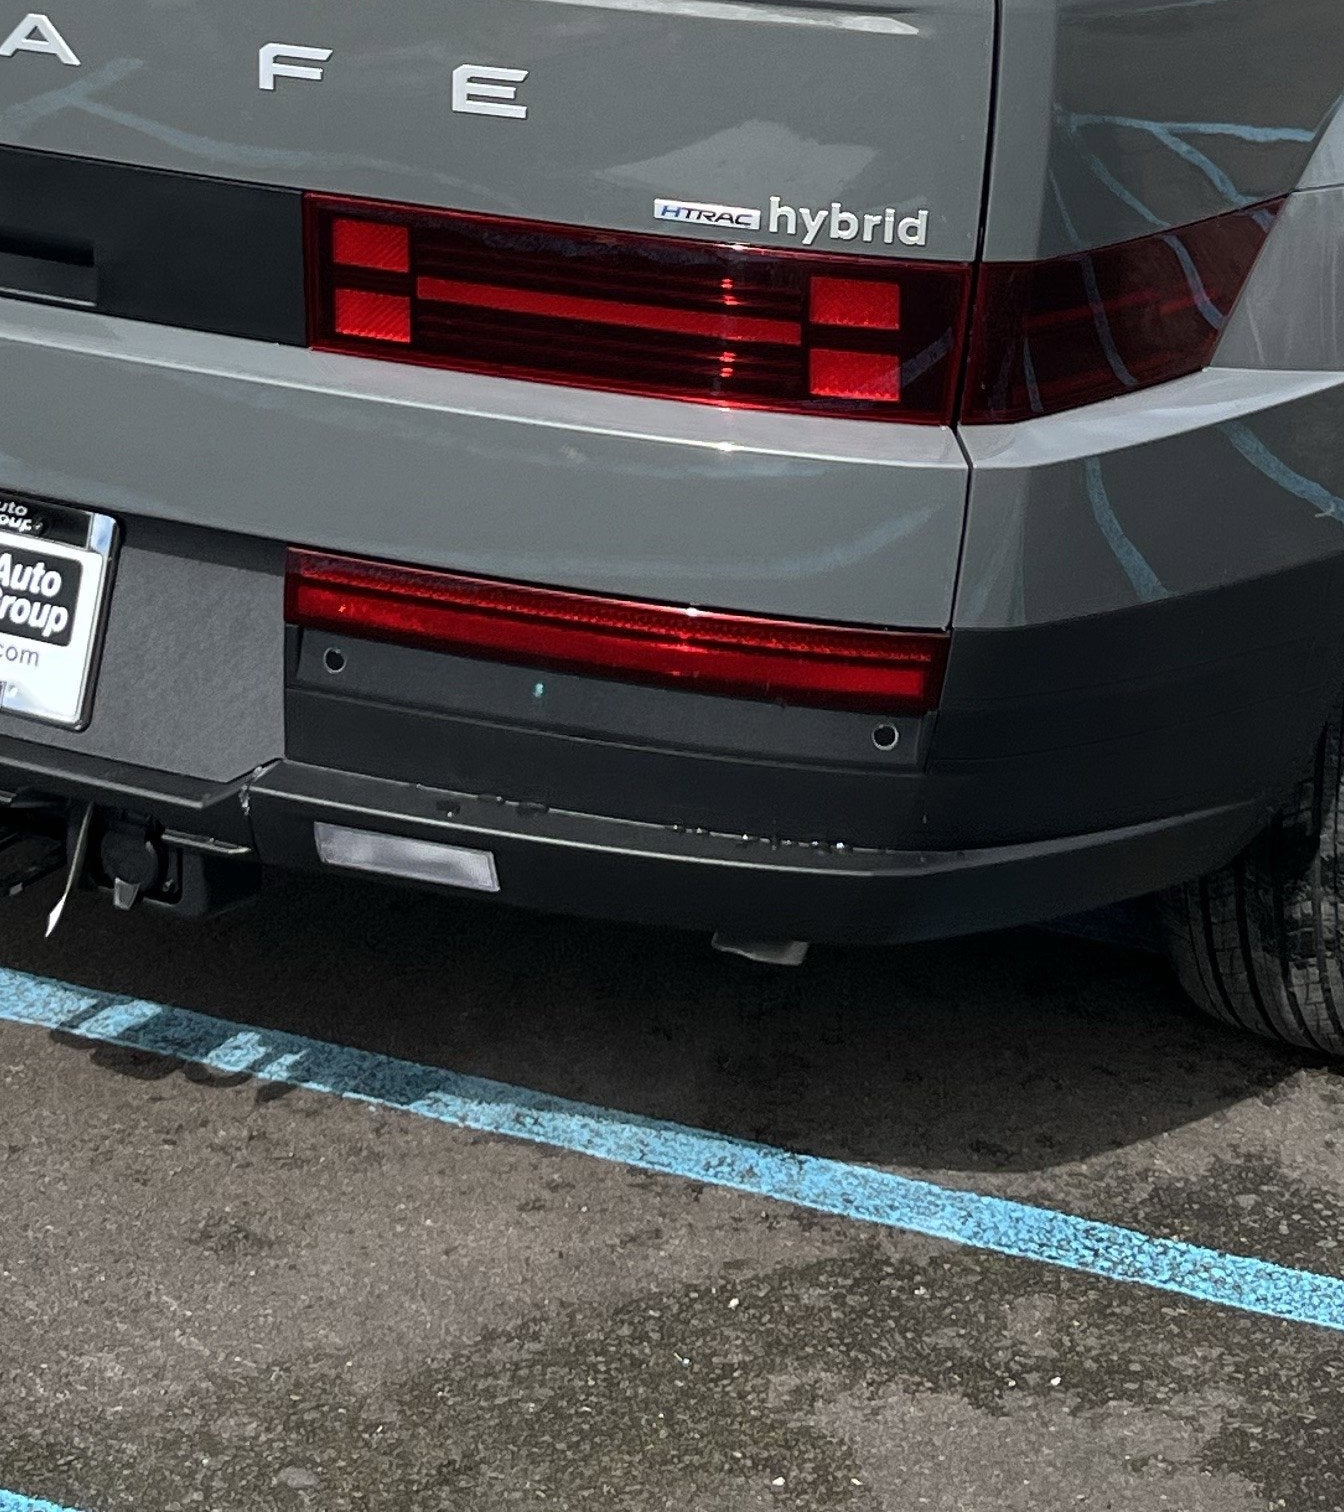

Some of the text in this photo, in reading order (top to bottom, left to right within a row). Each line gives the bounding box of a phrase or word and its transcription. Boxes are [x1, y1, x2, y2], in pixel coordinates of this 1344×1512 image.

[258, 42, 529, 119] FE
[660, 196, 929, 246] HTRAC hybrid
